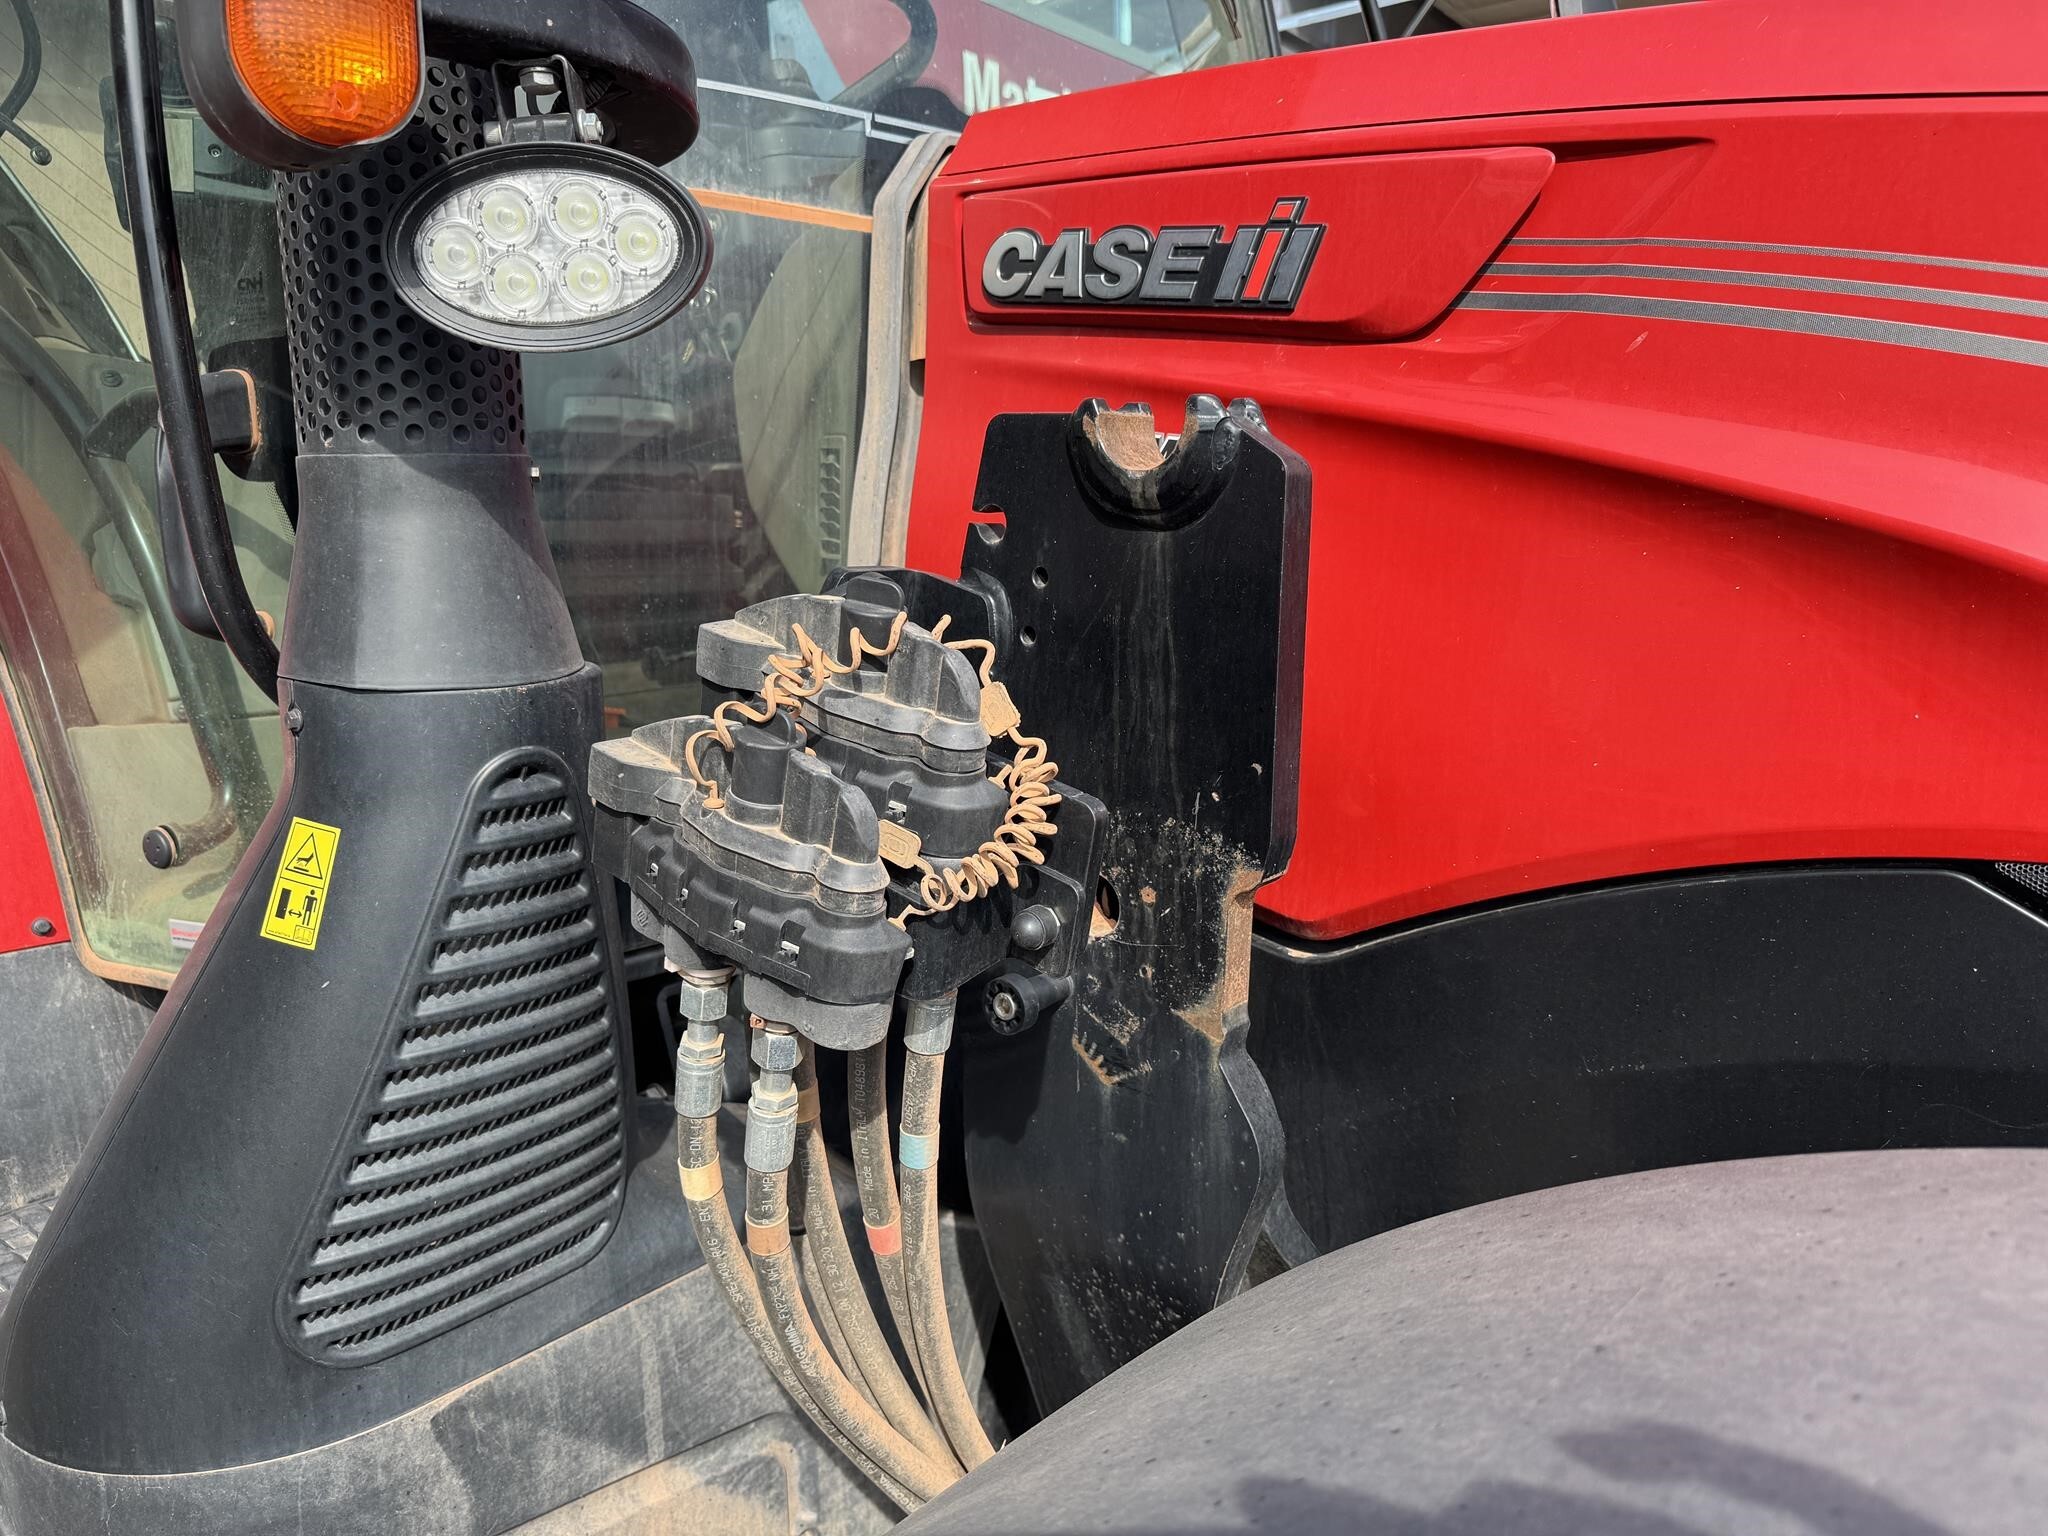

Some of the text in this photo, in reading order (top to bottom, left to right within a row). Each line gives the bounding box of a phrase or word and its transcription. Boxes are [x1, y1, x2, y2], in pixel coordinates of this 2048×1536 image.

[982, 226, 1218, 299] CASE
[689, 1136, 703, 1150] DN
[860, 1148, 869, 1158] in
[861, 1165, 873, 1191] Made
